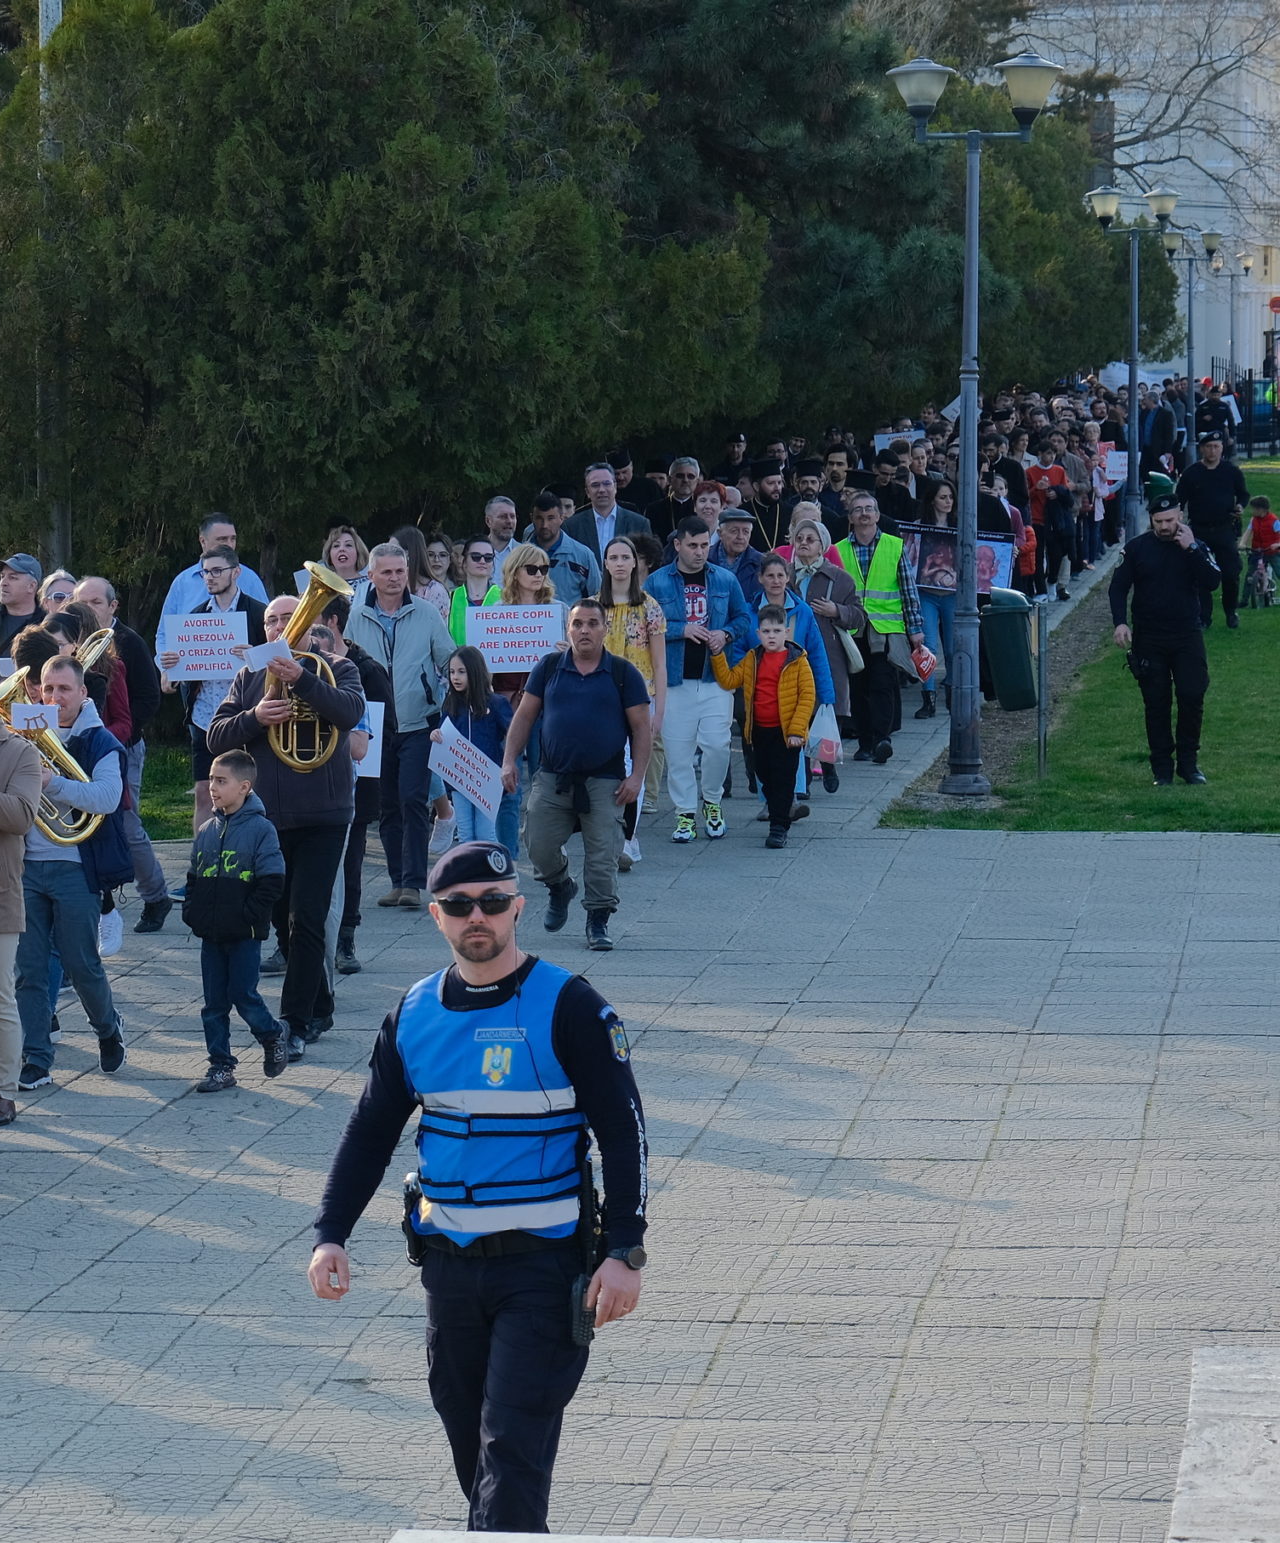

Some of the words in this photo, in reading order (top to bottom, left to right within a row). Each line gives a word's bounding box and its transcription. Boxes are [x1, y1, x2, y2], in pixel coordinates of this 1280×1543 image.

[475, 611, 519, 620] FIECARE
[522, 610, 554, 619] COPIL
[183, 619, 226, 628] AVORTUL
[486, 624, 543, 635] NENĂSCUT
[177, 634, 190, 643] NU
[480, 641, 499, 649] ARE
[503, 640, 551, 649] DREPTUL
[178, 649, 186, 657] O
[217, 648, 227, 656] CI
[491, 656, 505, 664] LA
[456, 738, 489, 768] COPILUL
[454, 762, 475, 781] ESTE
[476, 780, 482, 788] O
